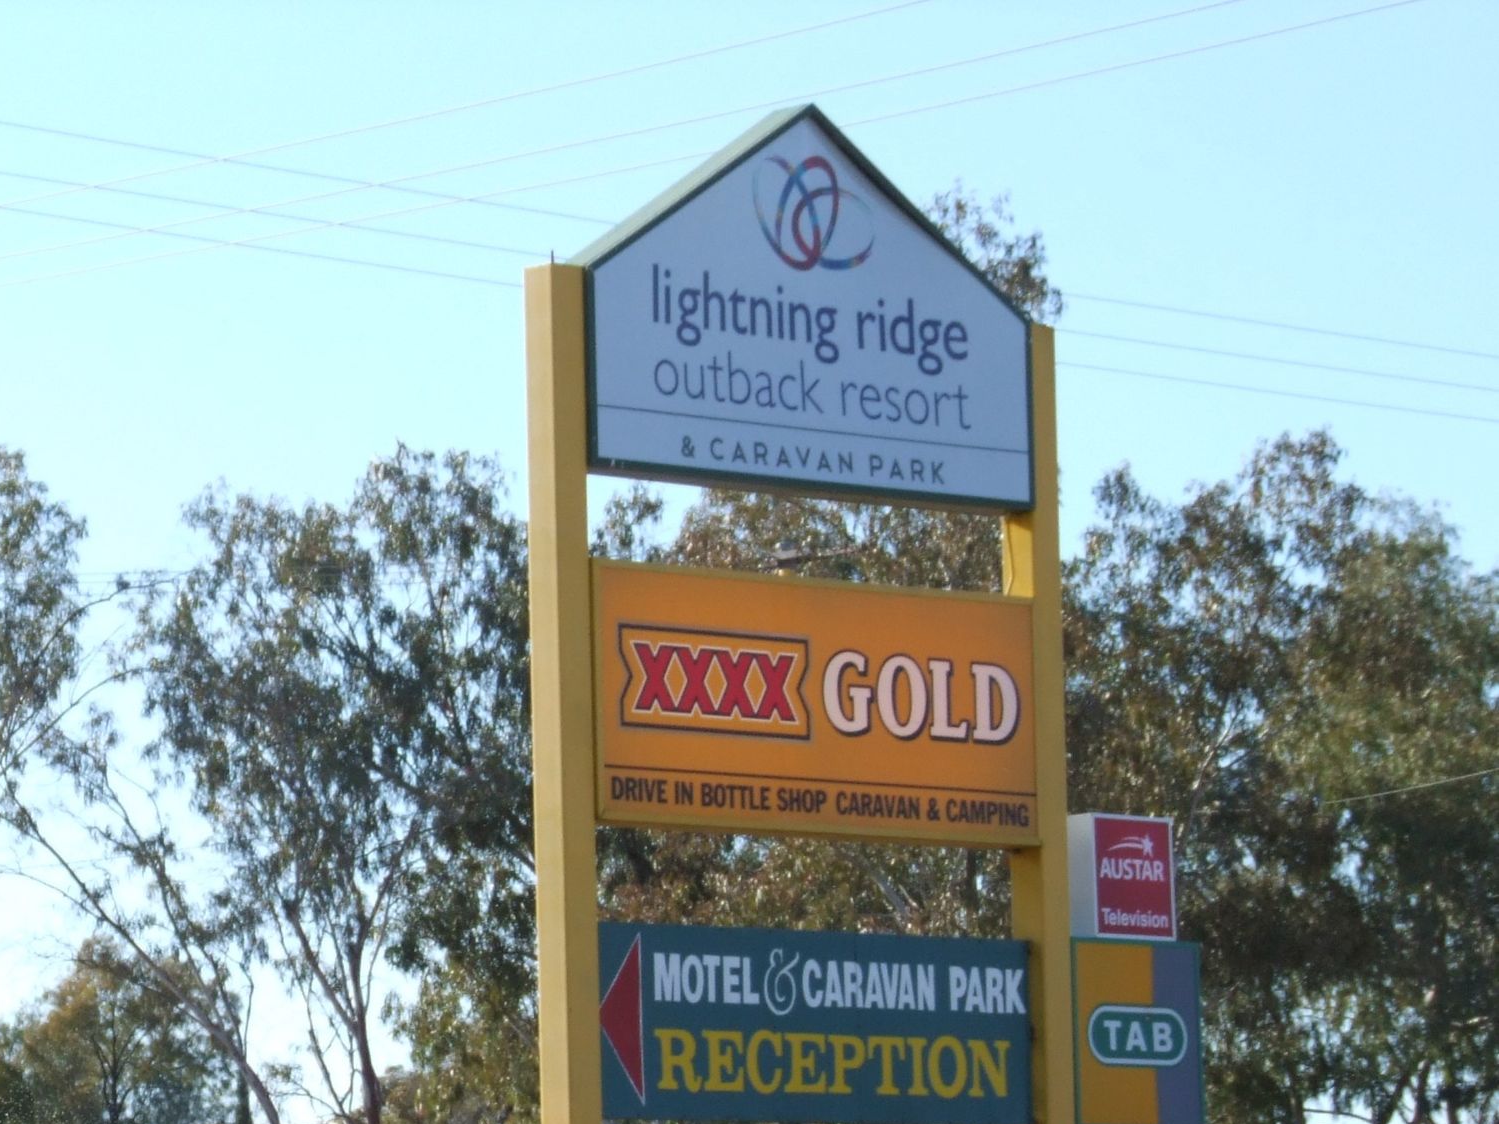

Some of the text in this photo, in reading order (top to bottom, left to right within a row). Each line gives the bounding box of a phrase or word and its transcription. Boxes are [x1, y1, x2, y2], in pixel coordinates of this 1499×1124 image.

[651, 263, 969, 376] lightning ridge
[653, 351, 972, 430] outback resort
[681, 435, 946, 486] & CARAVAN PARK
[631, 640, 1021, 746] XXXX GOLD
[610, 775, 1030, 828] DRIVE IN BOTTLE SHOP CARAVAN & CAMPING
[1099, 856, 1165, 882] AUSTAR
[1100, 906, 1170, 929] Television
[653, 946, 1027, 1017] MOTEL & CARAVAN PARK
[656, 1028, 1010, 1097] RECEPTION
[1103, 1018, 1174, 1054] TAB
